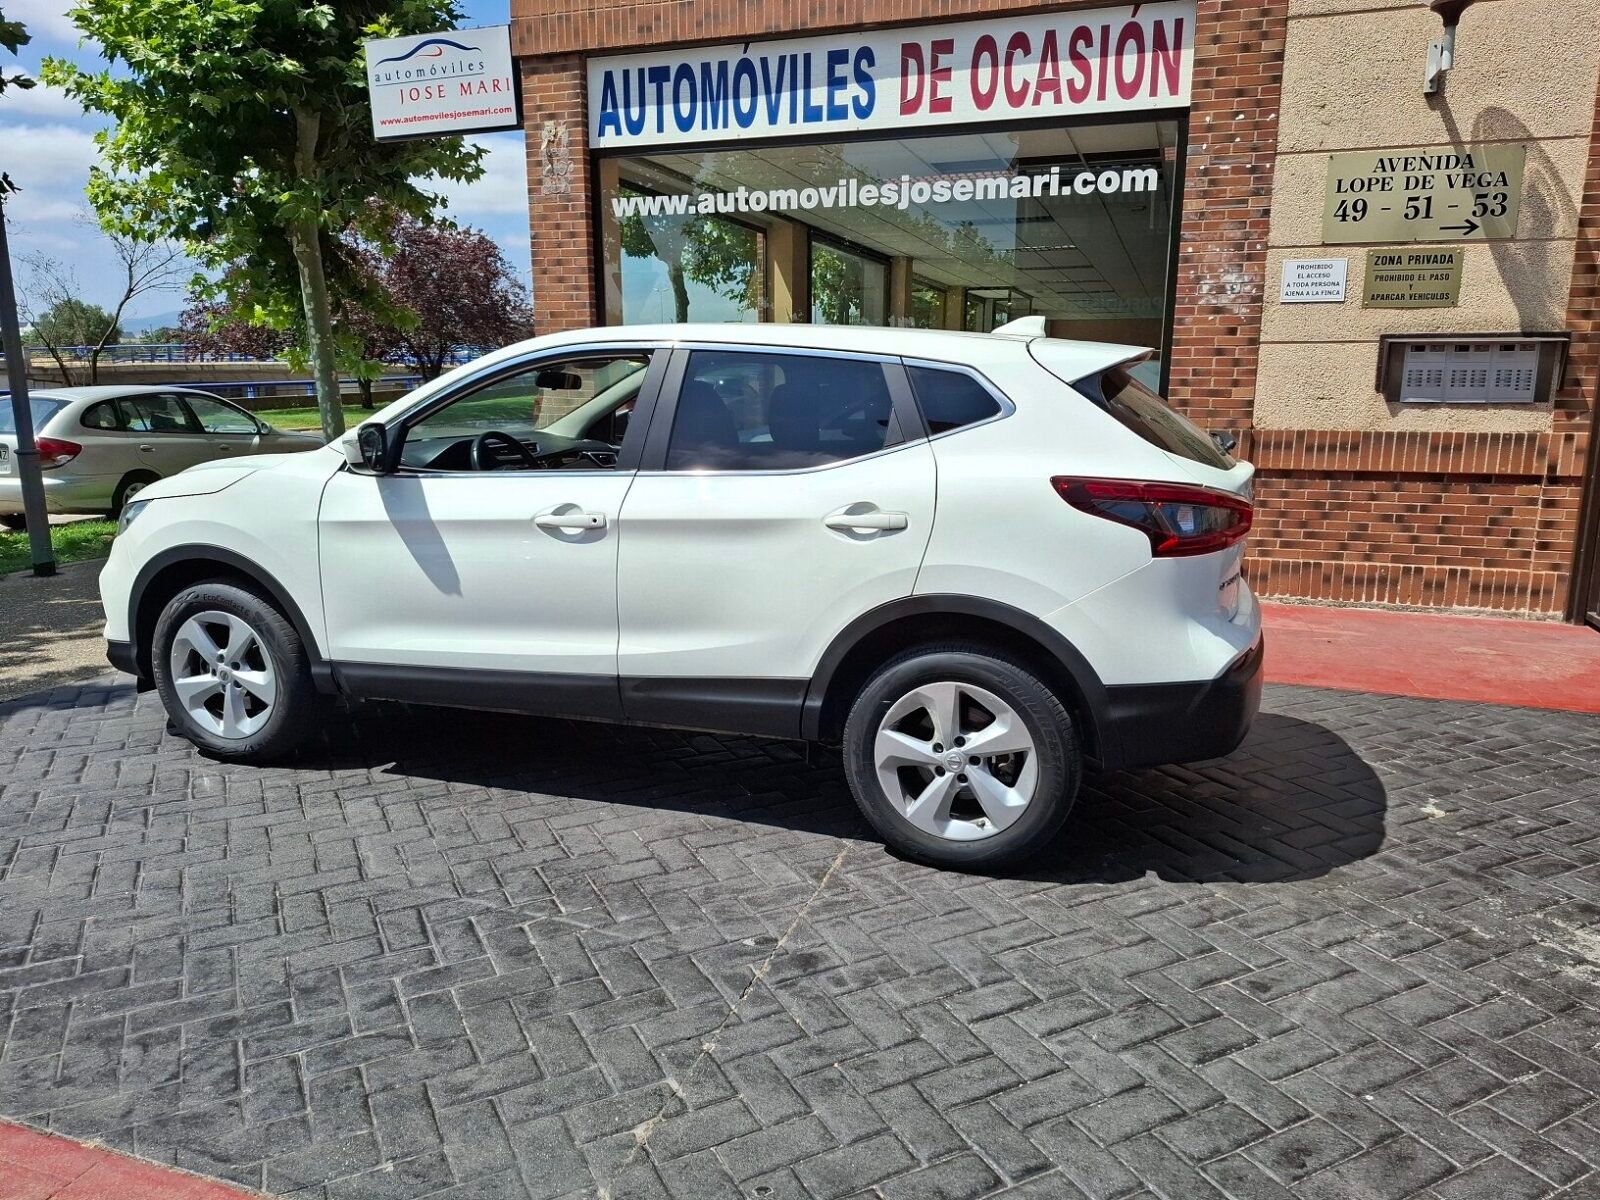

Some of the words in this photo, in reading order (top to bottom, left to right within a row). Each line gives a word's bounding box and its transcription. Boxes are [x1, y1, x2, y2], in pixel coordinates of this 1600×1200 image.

[375, 60, 485, 82] automóviles
[598, 43, 876, 137] AUTOMÓVILES
[900, 39, 954, 116] DE
[970, 5, 1184, 111] OCASIÓN
[400, 84, 446, 104] JOSE
[460, 78, 511, 96] MARI
[380, 106, 512, 126] www.automovilesjosemari.com
[1372, 154, 1475, 173] AVENIDA
[612, 167, 1158, 217] www.automovilesjosemari.com
[1335, 176, 1394, 193] LOPE
[1404, 175, 1435, 191] DE
[1446, 171, 1509, 189] VEGA
[1333, 198, 1368, 222] 49
[1403, 196, 1434, 220] 51
[1472, 192, 1508, 217] 53
[1374, 255, 1402, 266] ZONA
[1407, 254, 1454, 265] PRIVADA
[1374, 273, 1415, 282] PROHIBIDO
[1418, 273, 1426, 281] EL
[1429, 273, 1450, 281] PASO
[1370, 293, 1406, 301] APARCAR
[1409, 292, 1450, 301] VEHICULOS
